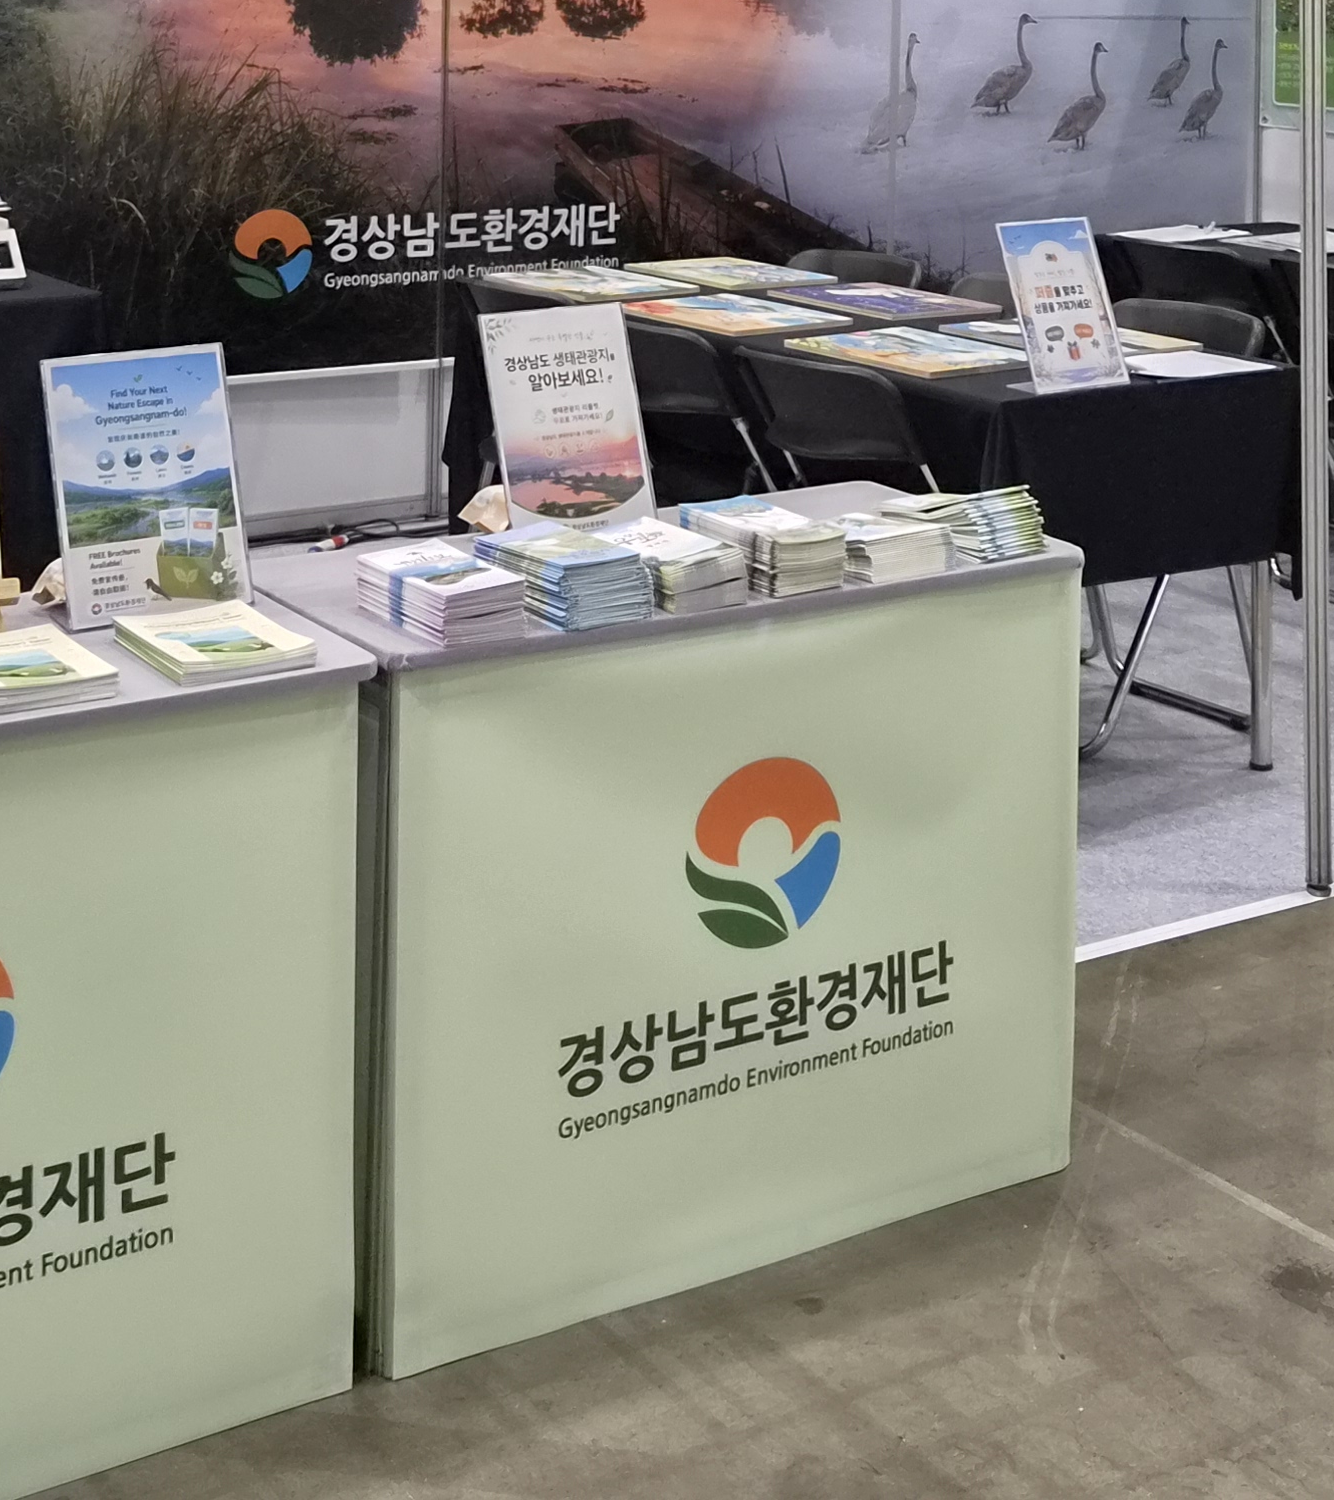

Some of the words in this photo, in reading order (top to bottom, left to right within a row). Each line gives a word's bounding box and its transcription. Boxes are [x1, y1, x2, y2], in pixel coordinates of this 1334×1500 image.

[323, 201, 621, 264] 경상남도환경재단
[504, 353, 552, 373] 경상남도
[527, 367, 605, 393] 알아보세요!
[107, 400, 136, 411] Nature
[136, 398, 165, 409] Escape
[110, 388, 128, 399] Find
[129, 387, 147, 397] Your
[148, 385, 169, 395] Next
[557, 939, 954, 1098] 경상남도환경재단
[558, 1073, 741, 1141] Gyeongsangnamdo
[746, 1041, 858, 1089] Environment
[861, 1017, 954, 1058] Foundation
[40, 1221, 175, 1278] Foundation
